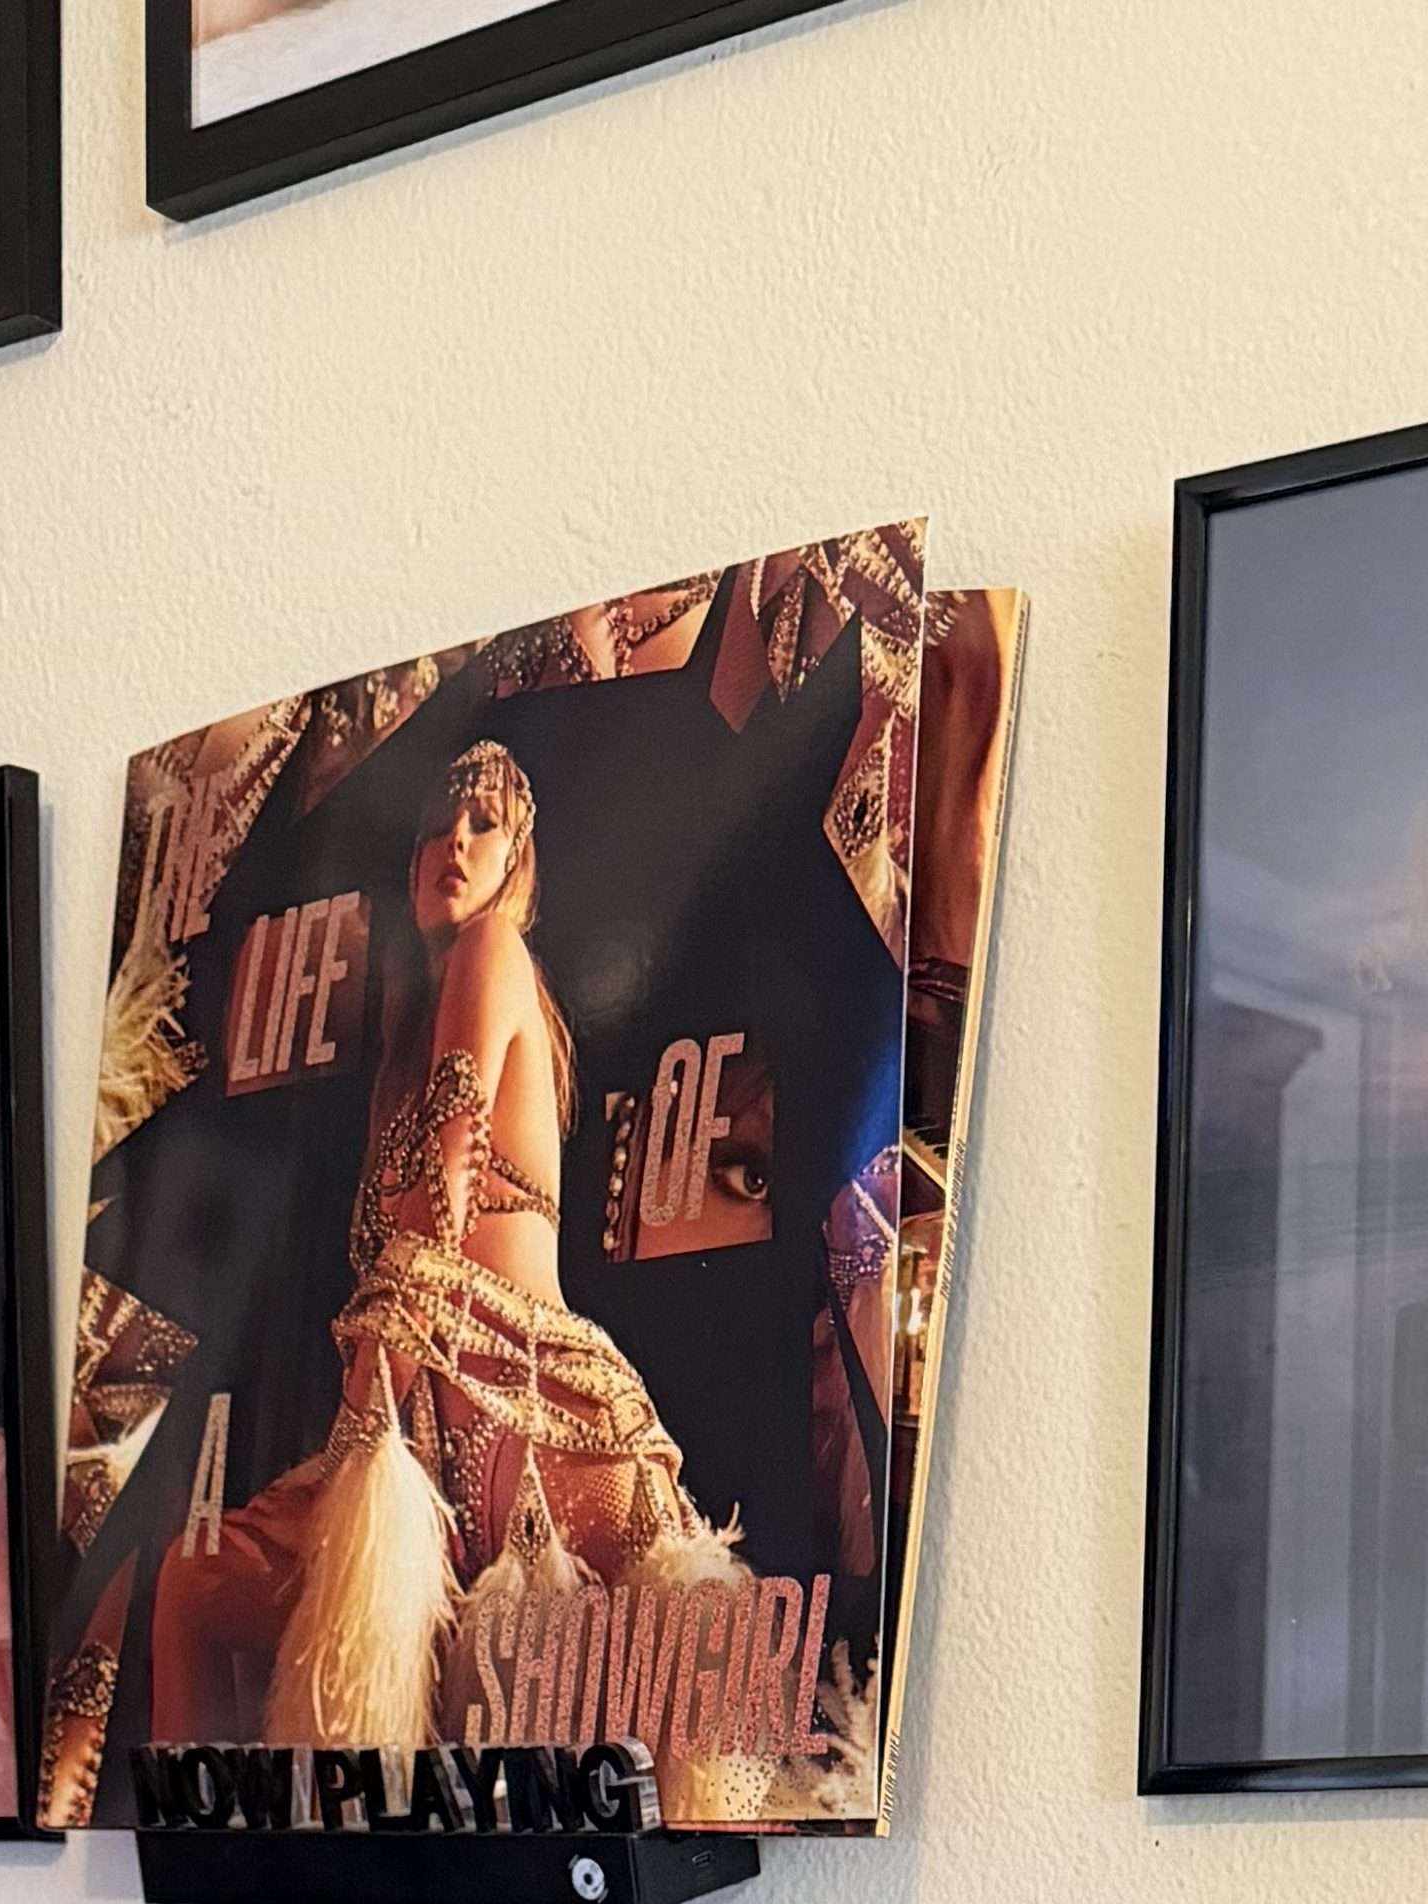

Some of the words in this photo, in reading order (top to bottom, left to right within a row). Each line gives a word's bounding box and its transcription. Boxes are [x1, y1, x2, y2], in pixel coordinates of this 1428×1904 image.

[227, 890, 360, 1083] LIFE
[640, 1031, 746, 1228] OF
[181, 1392, 232, 1559] A
[466, 1573, 832, 1758] SHOWGIRL
[128, 1743, 298, 1831] NOW
[314, 1736, 658, 1833] PLAYING
